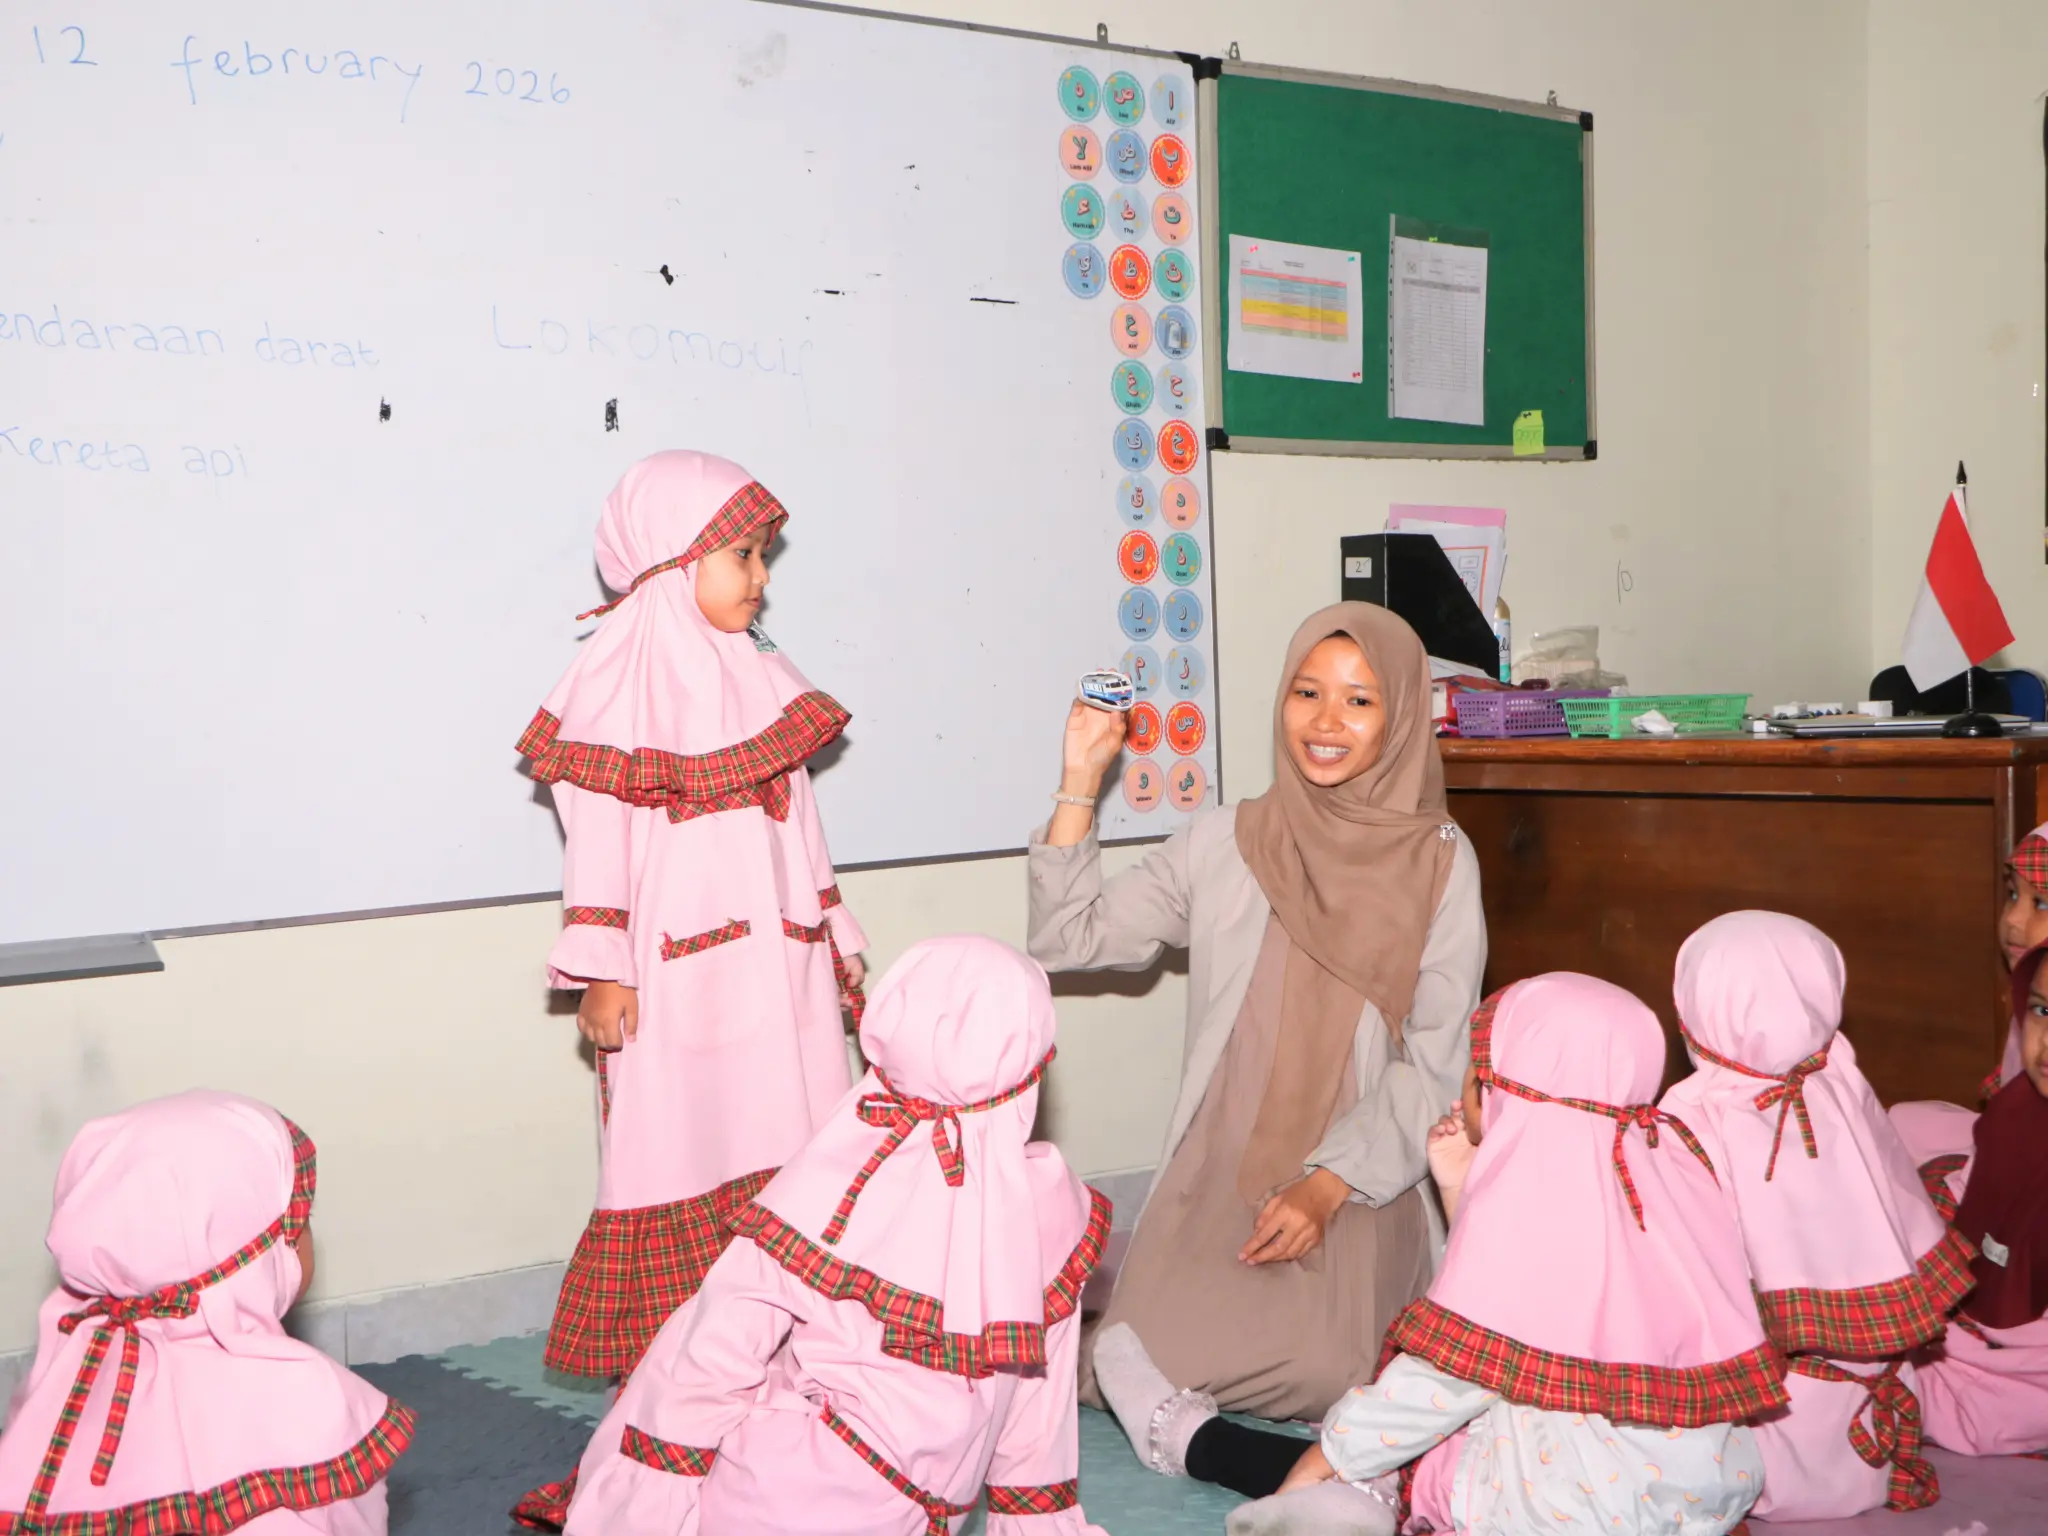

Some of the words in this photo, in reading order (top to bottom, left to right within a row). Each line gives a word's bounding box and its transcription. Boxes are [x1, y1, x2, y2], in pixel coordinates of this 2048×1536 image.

[32, 24, 98, 66] 12
[170, 35, 423, 123] february
[464, 60, 571, 104] 2026
[254, 320, 381, 369] darat
